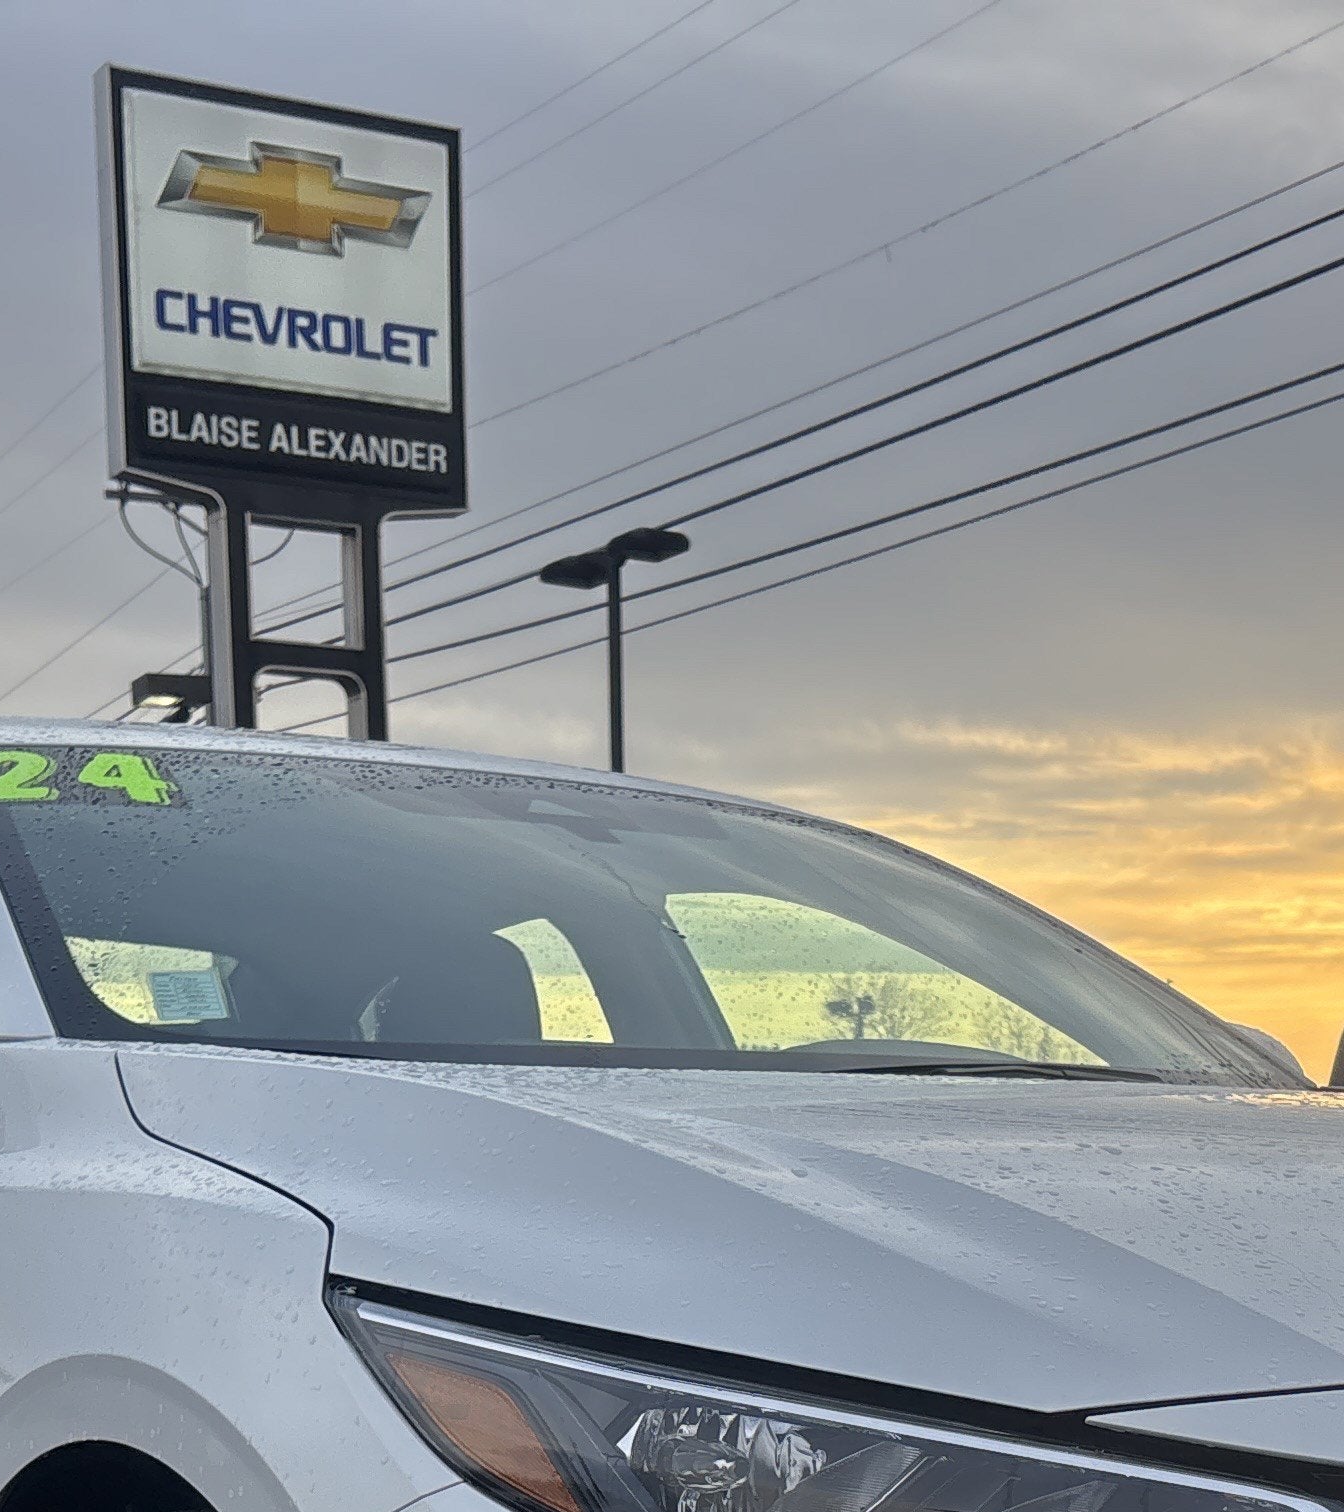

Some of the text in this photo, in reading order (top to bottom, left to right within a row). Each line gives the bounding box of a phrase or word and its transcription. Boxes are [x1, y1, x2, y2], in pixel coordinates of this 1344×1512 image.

[155, 288, 438, 368] CHEVROLET
[147, 406, 448, 474] BLAISE ALEXANDER
